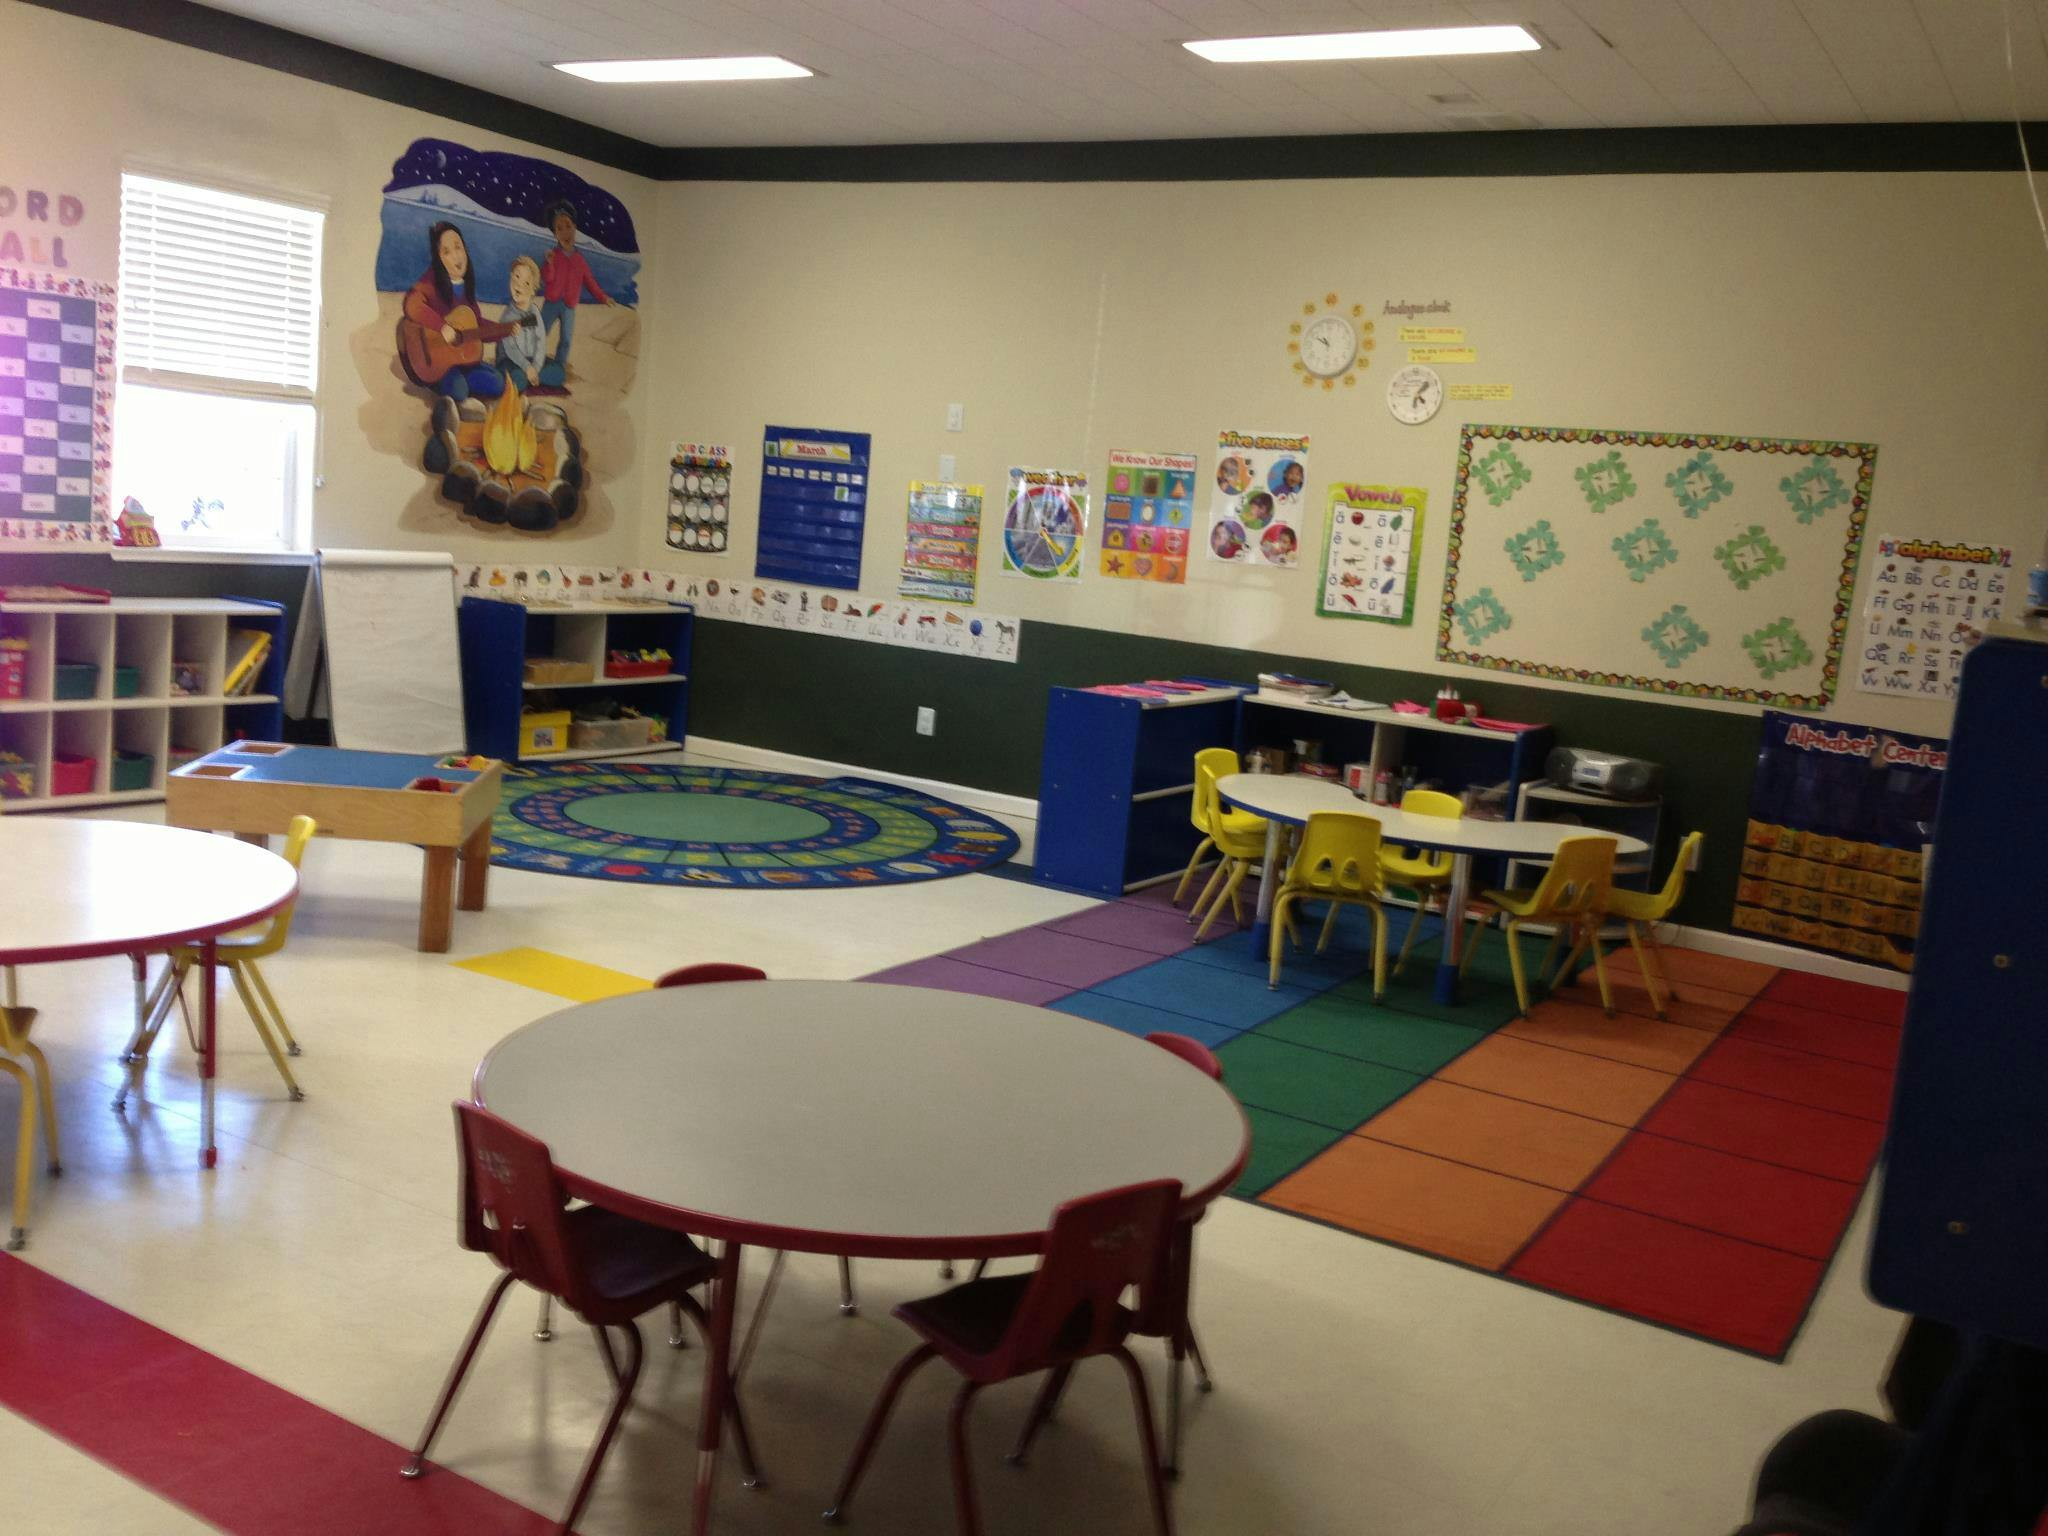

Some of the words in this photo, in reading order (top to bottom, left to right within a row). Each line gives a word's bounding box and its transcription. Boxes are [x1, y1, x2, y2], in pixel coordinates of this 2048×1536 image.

[797, 444, 827, 456] March
[1227, 431, 1254, 449] five
[1255, 436, 1303, 452] senses
[1112, 454, 1125, 463] We
[1126, 455, 1147, 465] Know
[1149, 456, 1164, 466] Our
[1025, 470, 1074, 488] weaher
[1344, 484, 1404, 504] Vowels
[1897, 539, 1992, 564] alphabet
[1785, 723, 1878, 758] Alphabet
